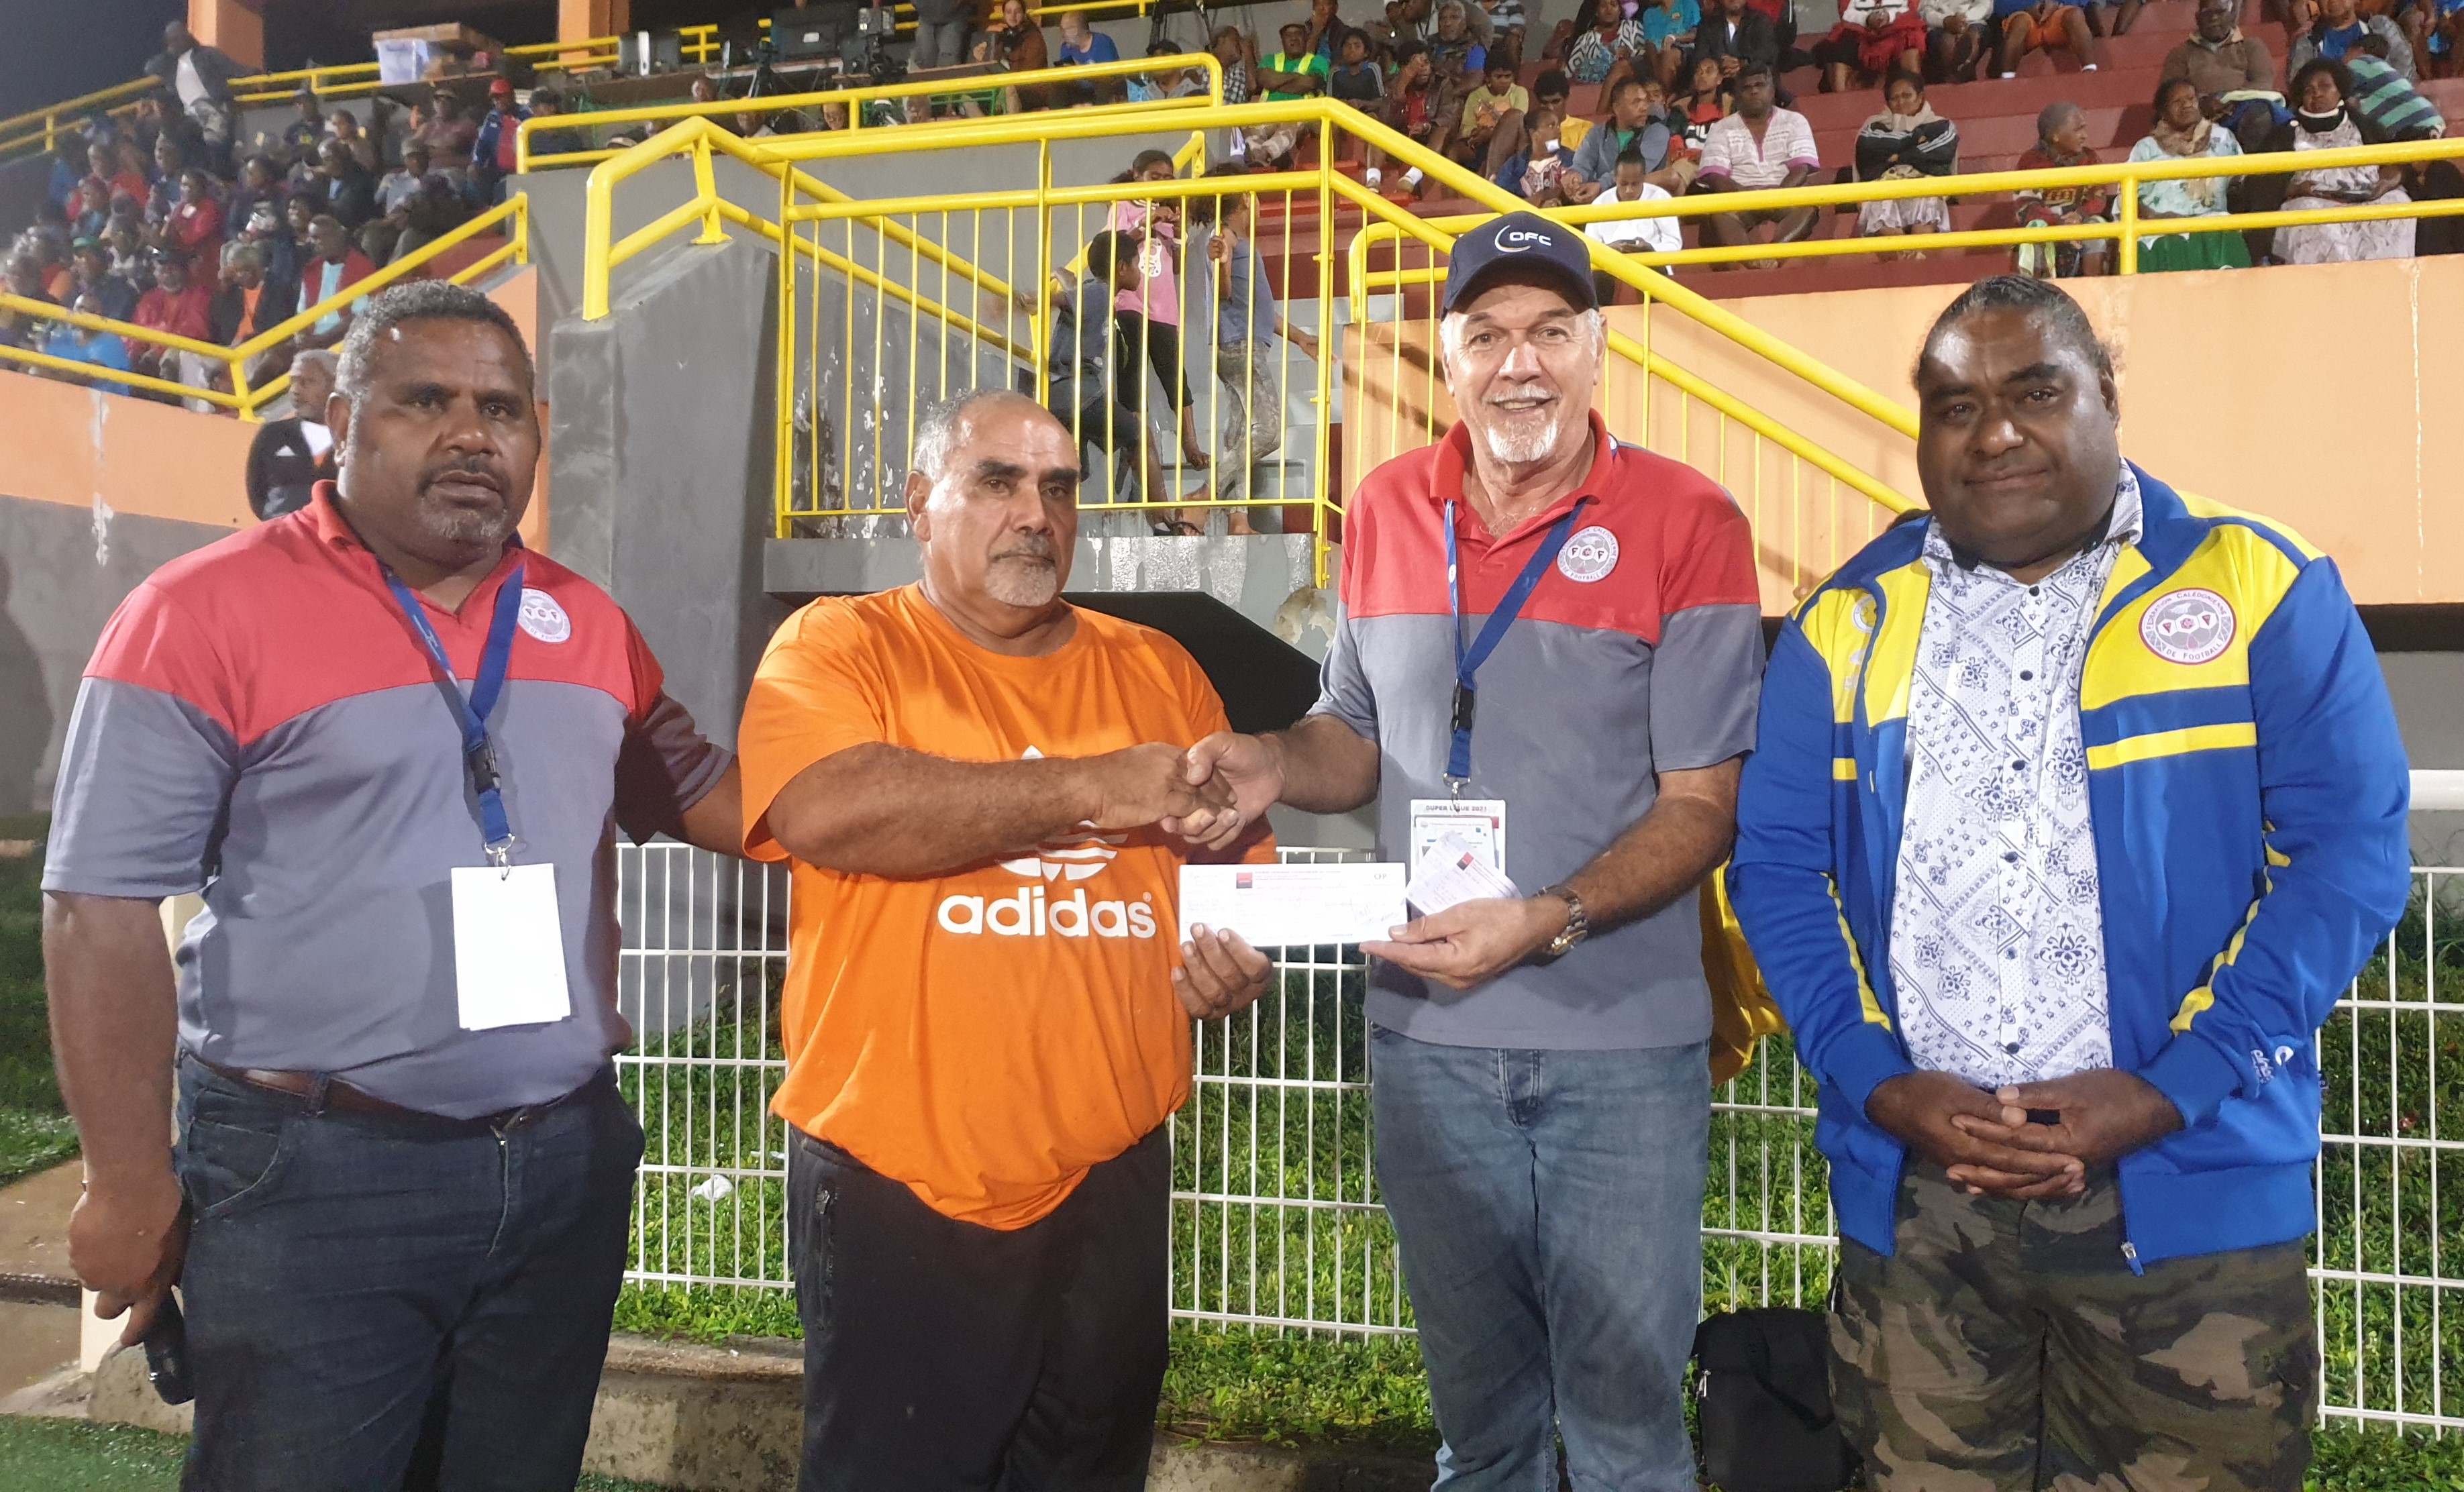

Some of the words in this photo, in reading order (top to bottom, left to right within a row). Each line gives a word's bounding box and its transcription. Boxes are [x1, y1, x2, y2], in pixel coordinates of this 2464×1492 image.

[1686, 124, 1708, 139] FIL
[1509, 231, 1552, 247] OFC
[2165, 648, 2177, 657] DE
[2183, 642, 2222, 661] FOOTBALL
[937, 885, 1156, 939] adidas
